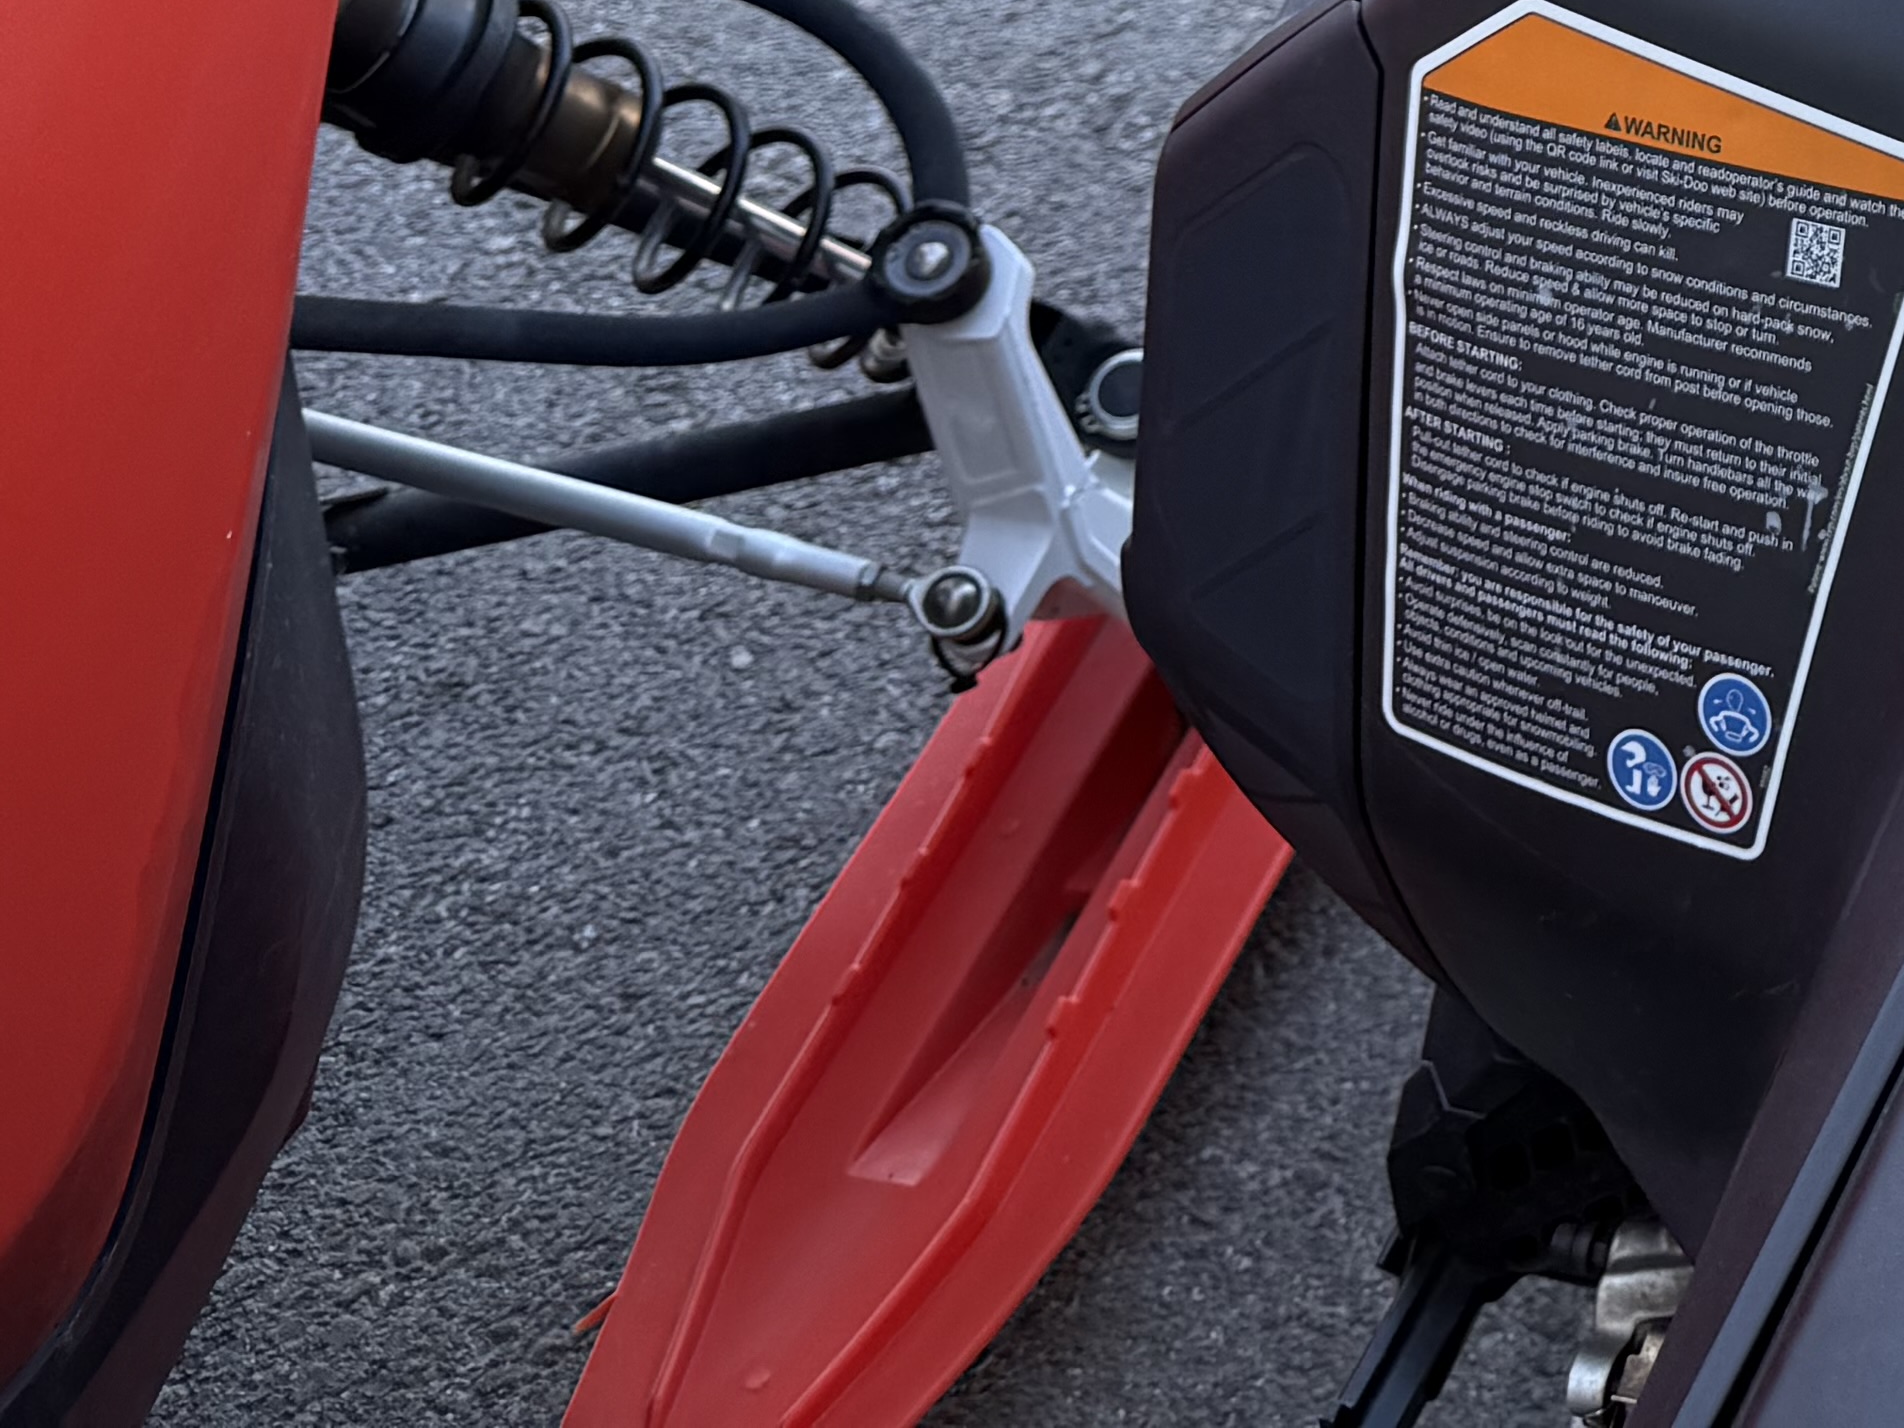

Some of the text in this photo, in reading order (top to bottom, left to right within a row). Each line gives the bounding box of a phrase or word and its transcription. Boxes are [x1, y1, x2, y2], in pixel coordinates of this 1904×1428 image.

[1427, 129, 1744, 228] Get familiar with your vehicle. Inexperienced riders may
[1428, 110, 1870, 228] safety video (using the QR code link or visit Ski-Doo web site) before operation.
[1429, 93, 1457, 115] Read
[1457, 102, 1477, 122] and
[1479, 109, 1540, 138] understand
[1541, 125, 1556, 142] all
[1557, 129, 1592, 153] safety
[1634, 147, 1670, 169] locate
[1671, 155, 1695, 174] and
[1785, 180, 1822, 205] guide
[1823, 189, 1847, 208] and
[1848, 194, 1886, 217] watch
[1624, 114, 1723, 155] WARNING
[1420, 202, 1874, 329] ALWAYS adjust your speed according to snow conditions and circumstances.
[1422, 179, 1680, 262] Excessive speed and reckless driving can kill.
